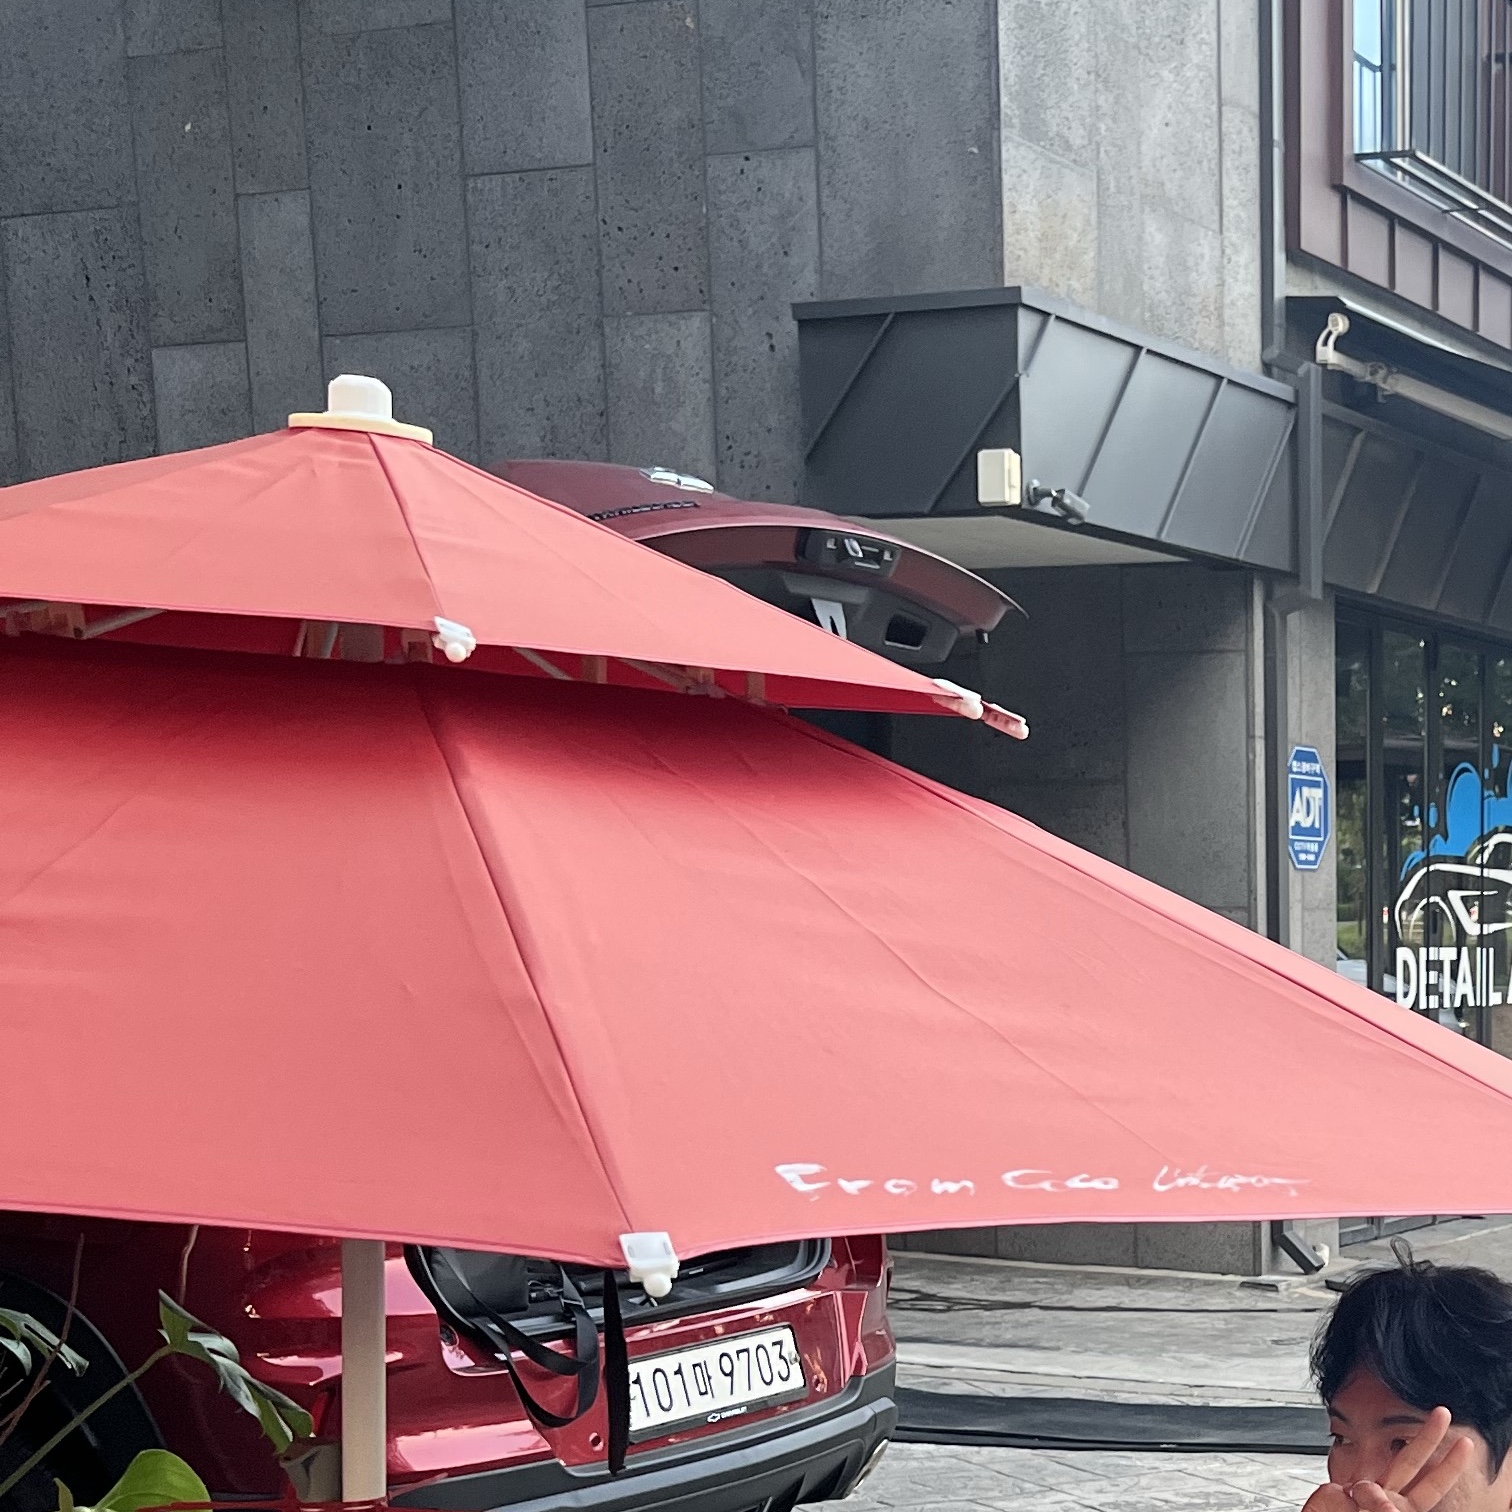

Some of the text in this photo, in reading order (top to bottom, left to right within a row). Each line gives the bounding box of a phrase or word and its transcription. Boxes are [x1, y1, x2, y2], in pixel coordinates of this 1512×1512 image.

[1290, 786, 1322, 829] ADT
[1396, 946, 1502, 1010] DETAIL
[719, 1339, 791, 1396] 9703
